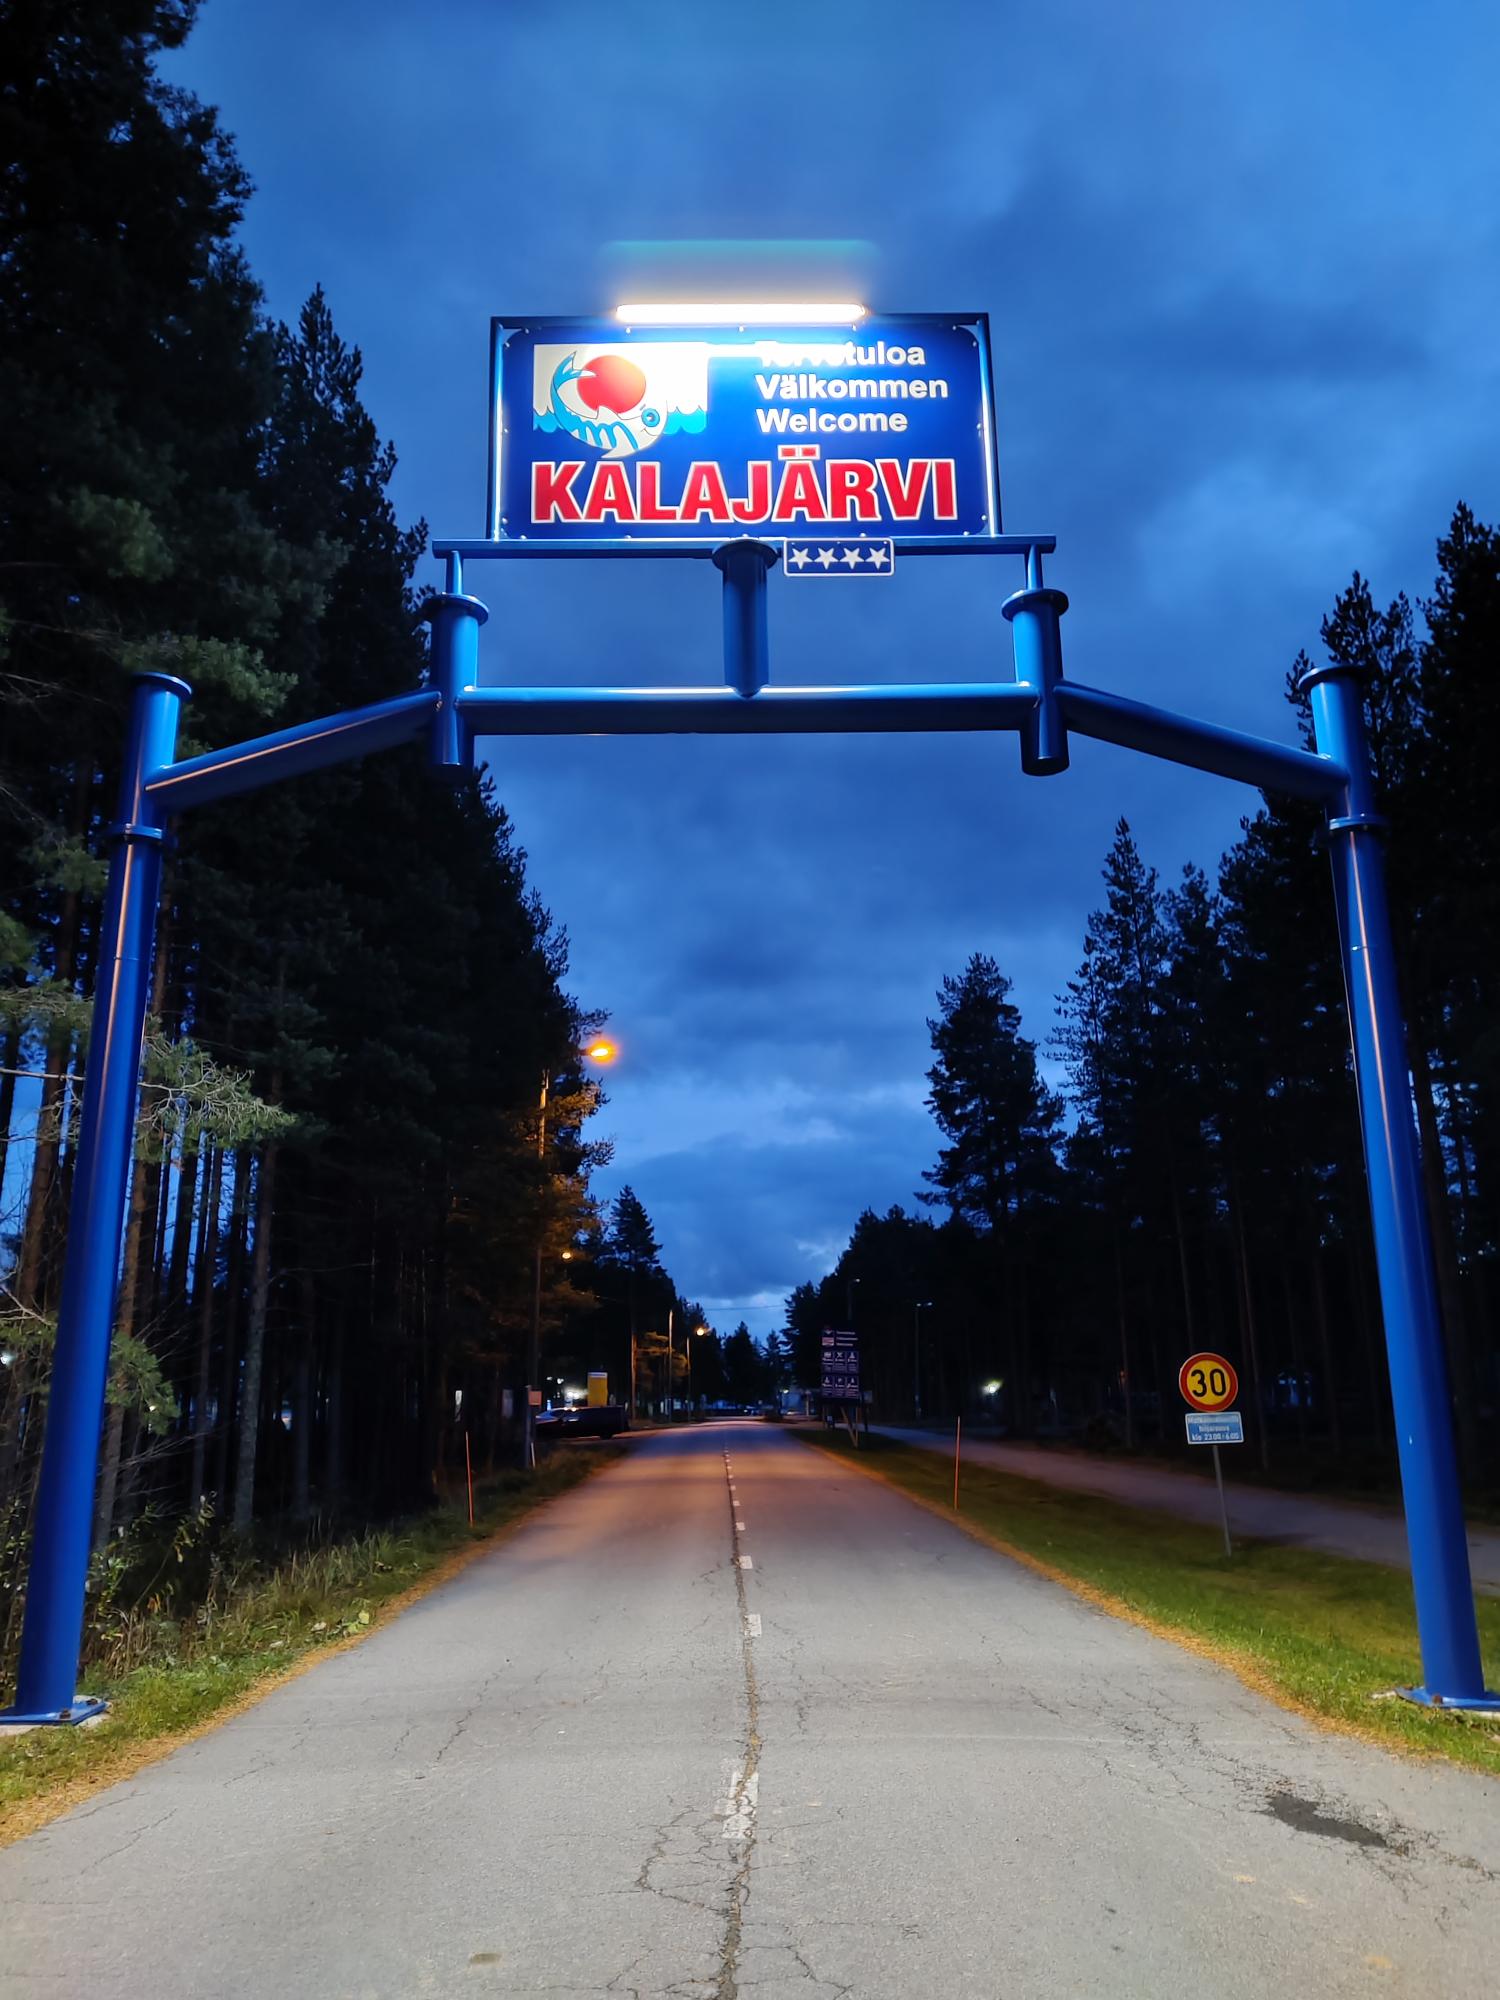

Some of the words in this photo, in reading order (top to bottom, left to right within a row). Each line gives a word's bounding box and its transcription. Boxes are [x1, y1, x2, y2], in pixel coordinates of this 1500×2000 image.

[755, 374, 948, 400] Välkommen
[756, 407, 909, 433] Welcome
[531, 444, 958, 524] KALAJÄRVI
[1191, 1368, 1226, 1397] 30
